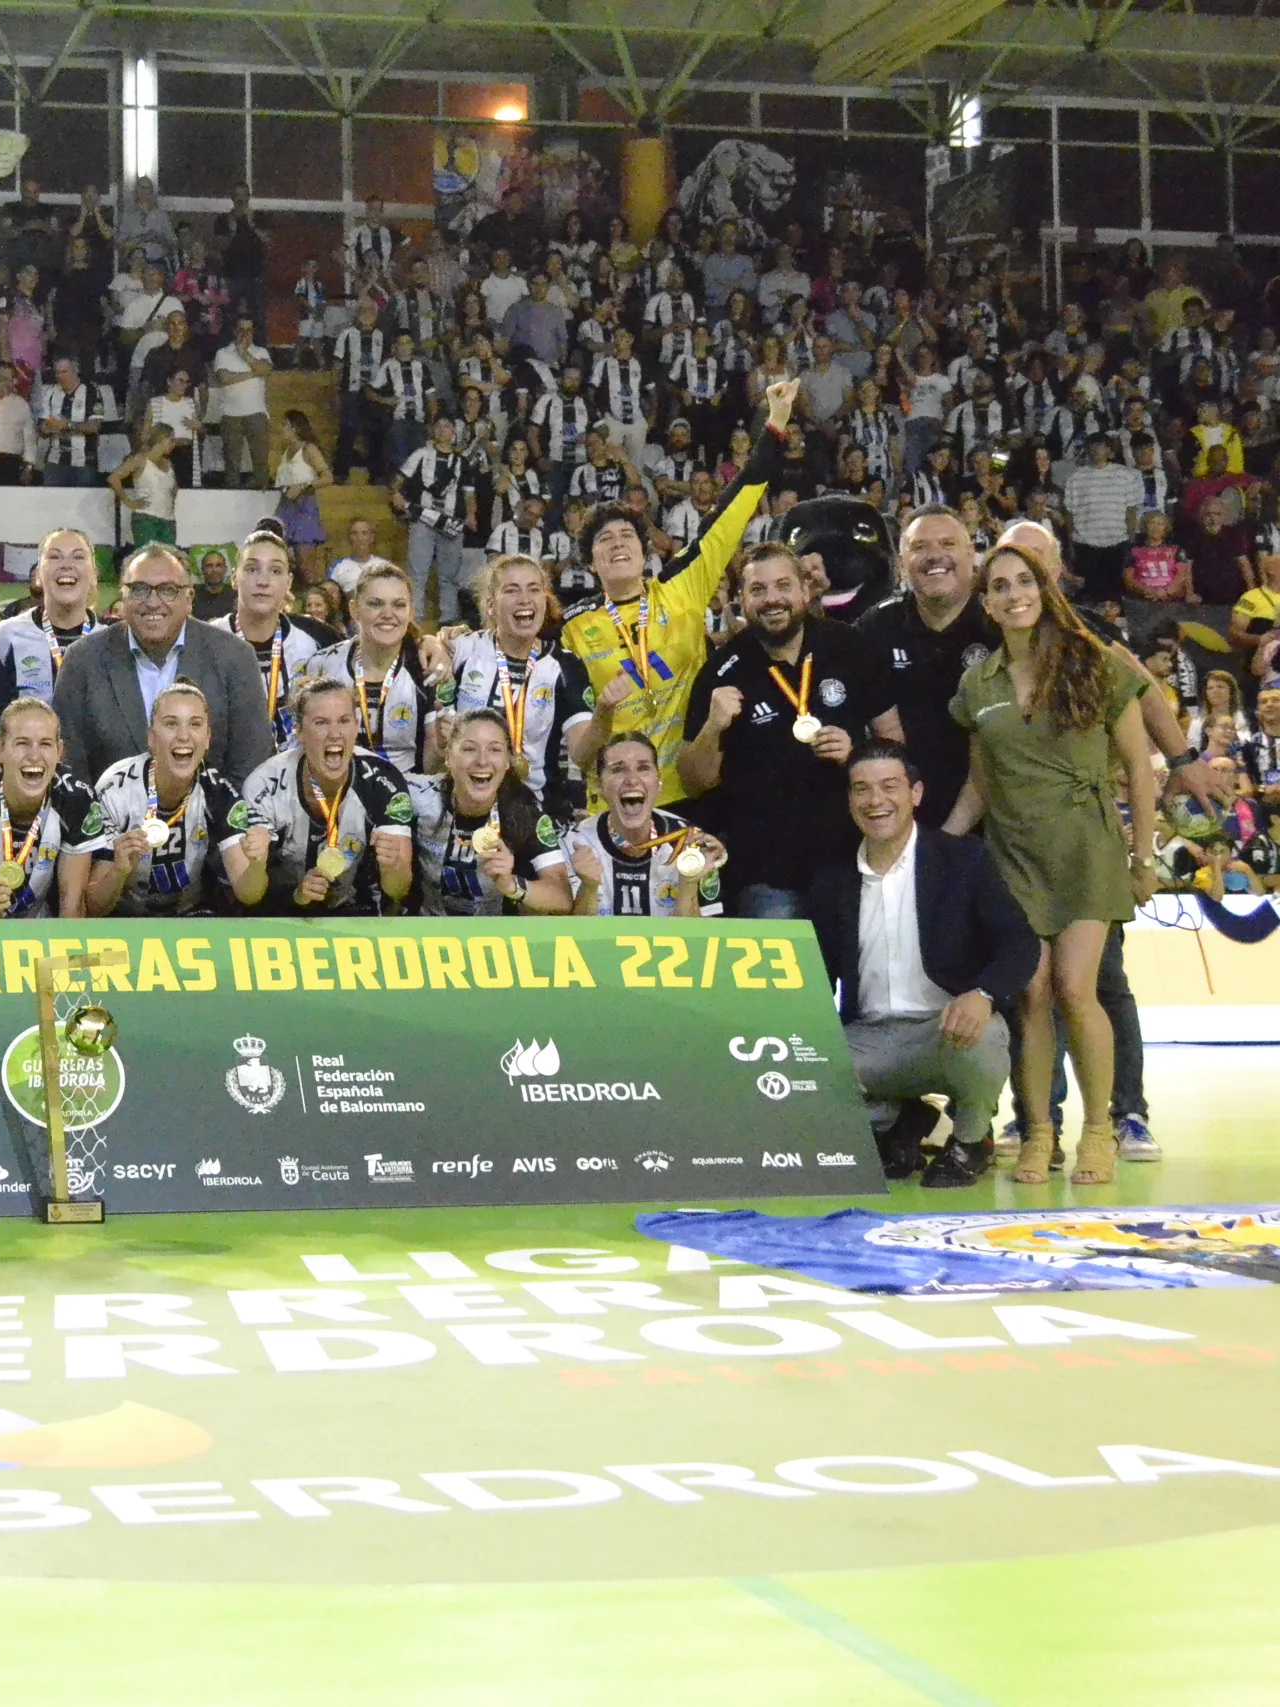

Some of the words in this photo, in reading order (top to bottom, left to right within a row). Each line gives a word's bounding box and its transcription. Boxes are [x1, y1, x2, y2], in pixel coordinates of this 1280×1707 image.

[620, 884, 643, 914] 11
[228, 934, 597, 992] IBERDROLA
[615, 934, 804, 990] 22/23
[22, 1058, 105, 1073] GURERAS
[311, 1054, 345, 1068] Real
[28, 1073, 106, 1088] IBDROLA
[314, 1069, 396, 1083] Federación
[316, 1085, 384, 1099] Española
[521, 1081, 662, 1103] IBERDROLA
[319, 1101, 338, 1114] de
[340, 1100, 426, 1114] Balonmano
[633, 1150, 675, 1163] SPAGNOLO
[691, 1156, 744, 1167] aquaservice
[761, 1151, 803, 1168] AON
[816, 1152, 856, 1165] Gerflor
[113, 1163, 177, 1180] sacyr
[432, 1154, 494, 1179] renfe
[512, 1157, 557, 1173] AVIS
[202, 1176, 263, 1186] IBERDROLA
[312, 1170, 350, 1181] Ceuta
